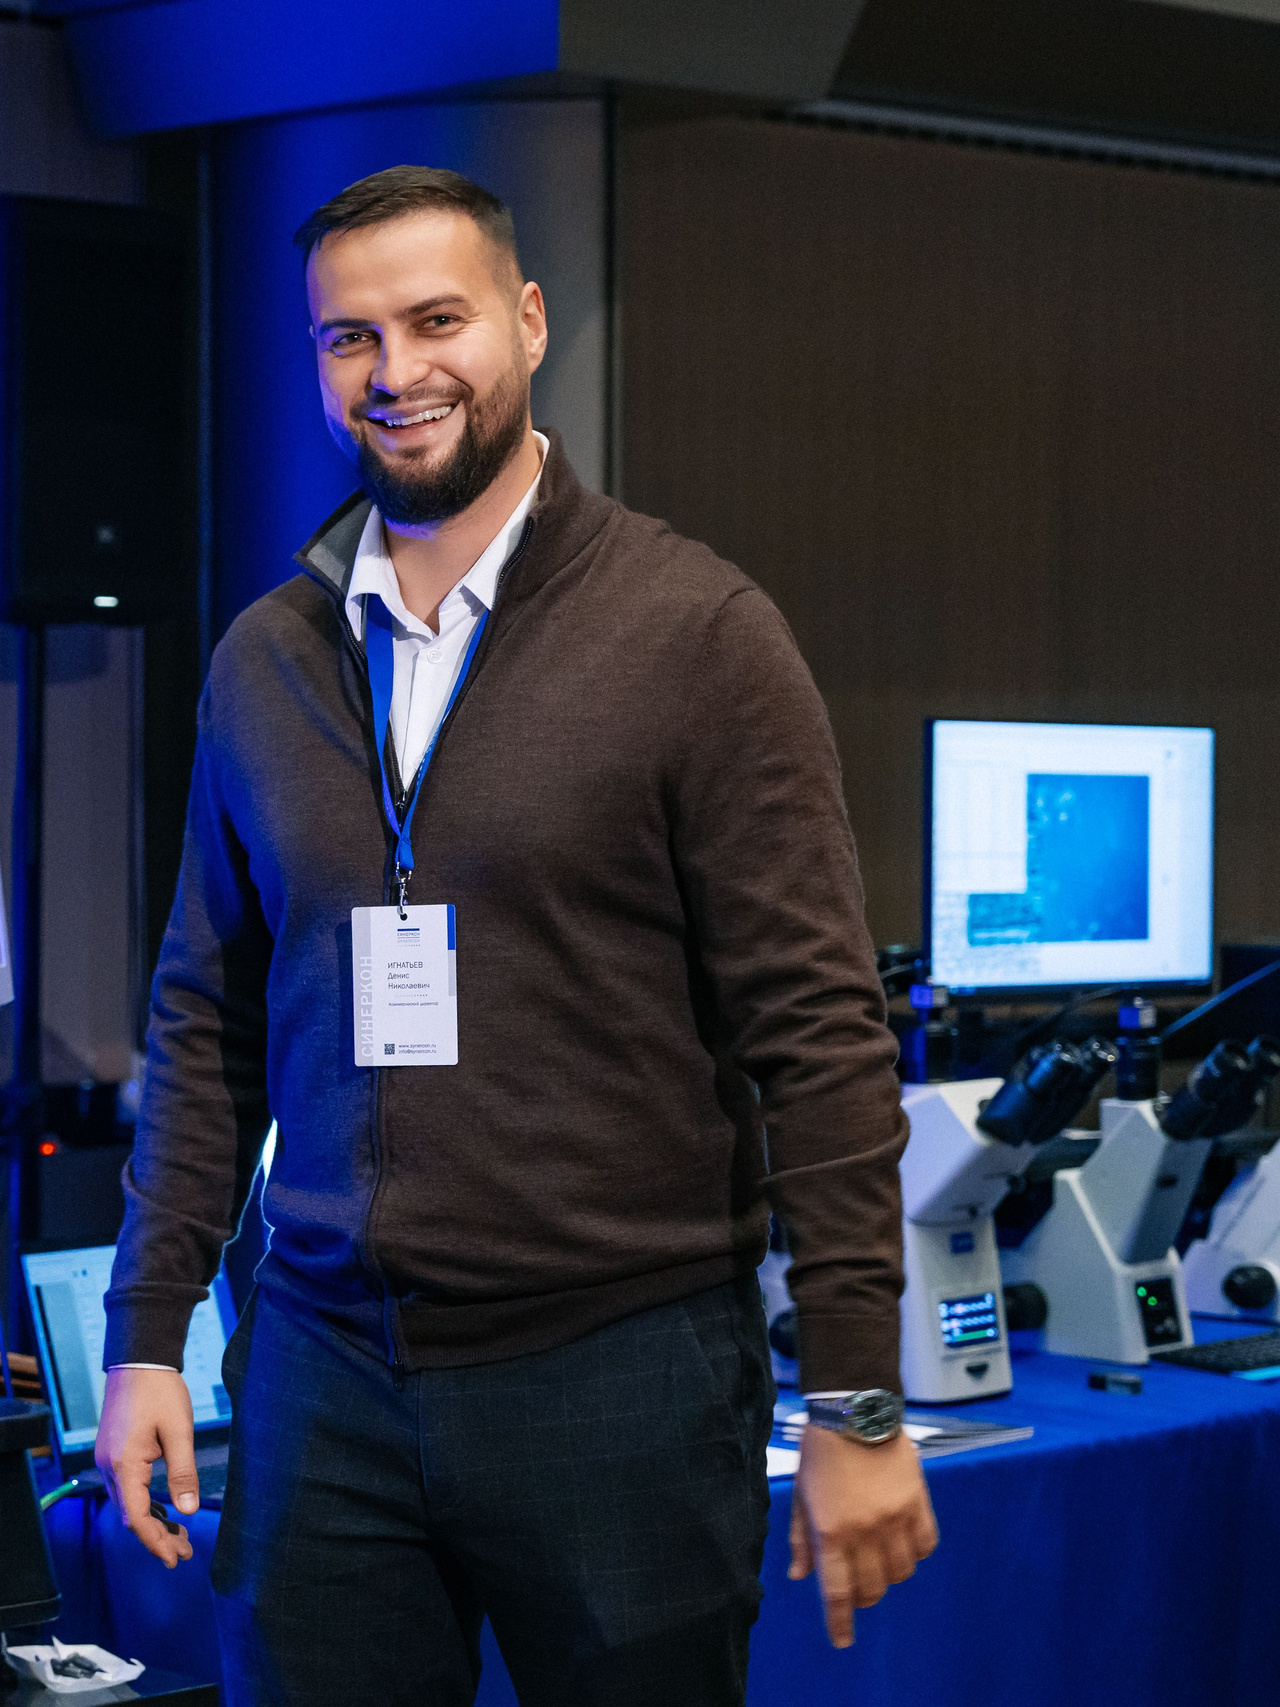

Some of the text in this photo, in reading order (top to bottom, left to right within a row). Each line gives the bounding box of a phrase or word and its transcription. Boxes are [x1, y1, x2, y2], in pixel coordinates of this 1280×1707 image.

[387, 961, 424, 969] ИГНАТЬЕВ
[387, 972, 410, 980] Денис
[359, 955, 373, 1058] СИНЕРКОН
